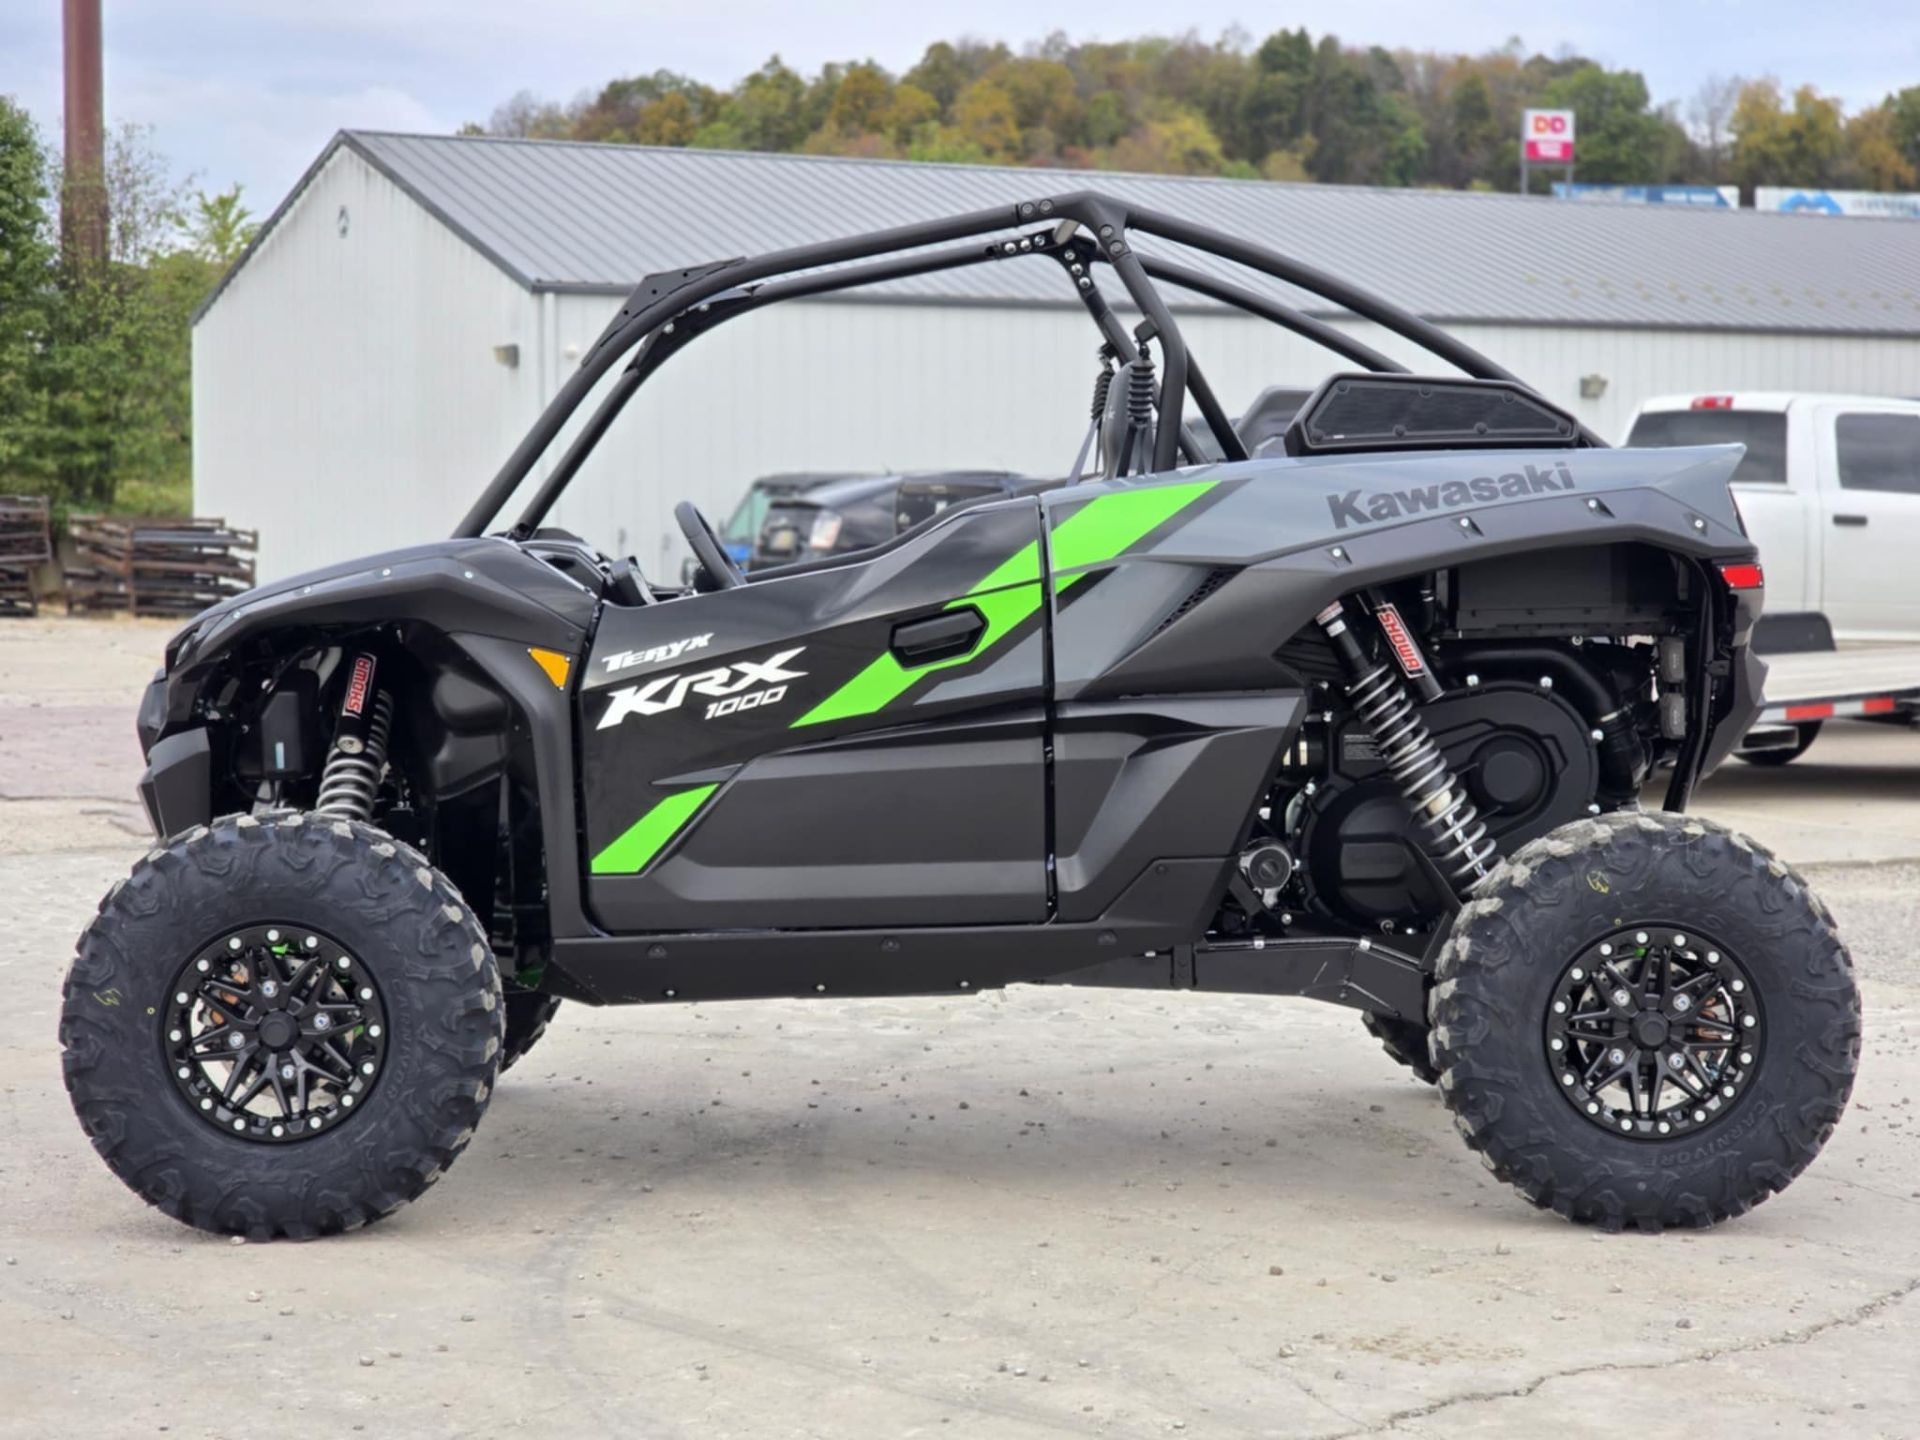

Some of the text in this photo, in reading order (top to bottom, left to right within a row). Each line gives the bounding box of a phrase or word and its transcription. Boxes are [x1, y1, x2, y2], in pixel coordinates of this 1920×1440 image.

[1326, 461, 1576, 530] Kawasaki
[1378, 611, 1422, 669] SHOWA
[346, 657, 370, 714] SHOWA
[595, 645, 809, 731] KRX
[704, 685, 789, 720] 1000
